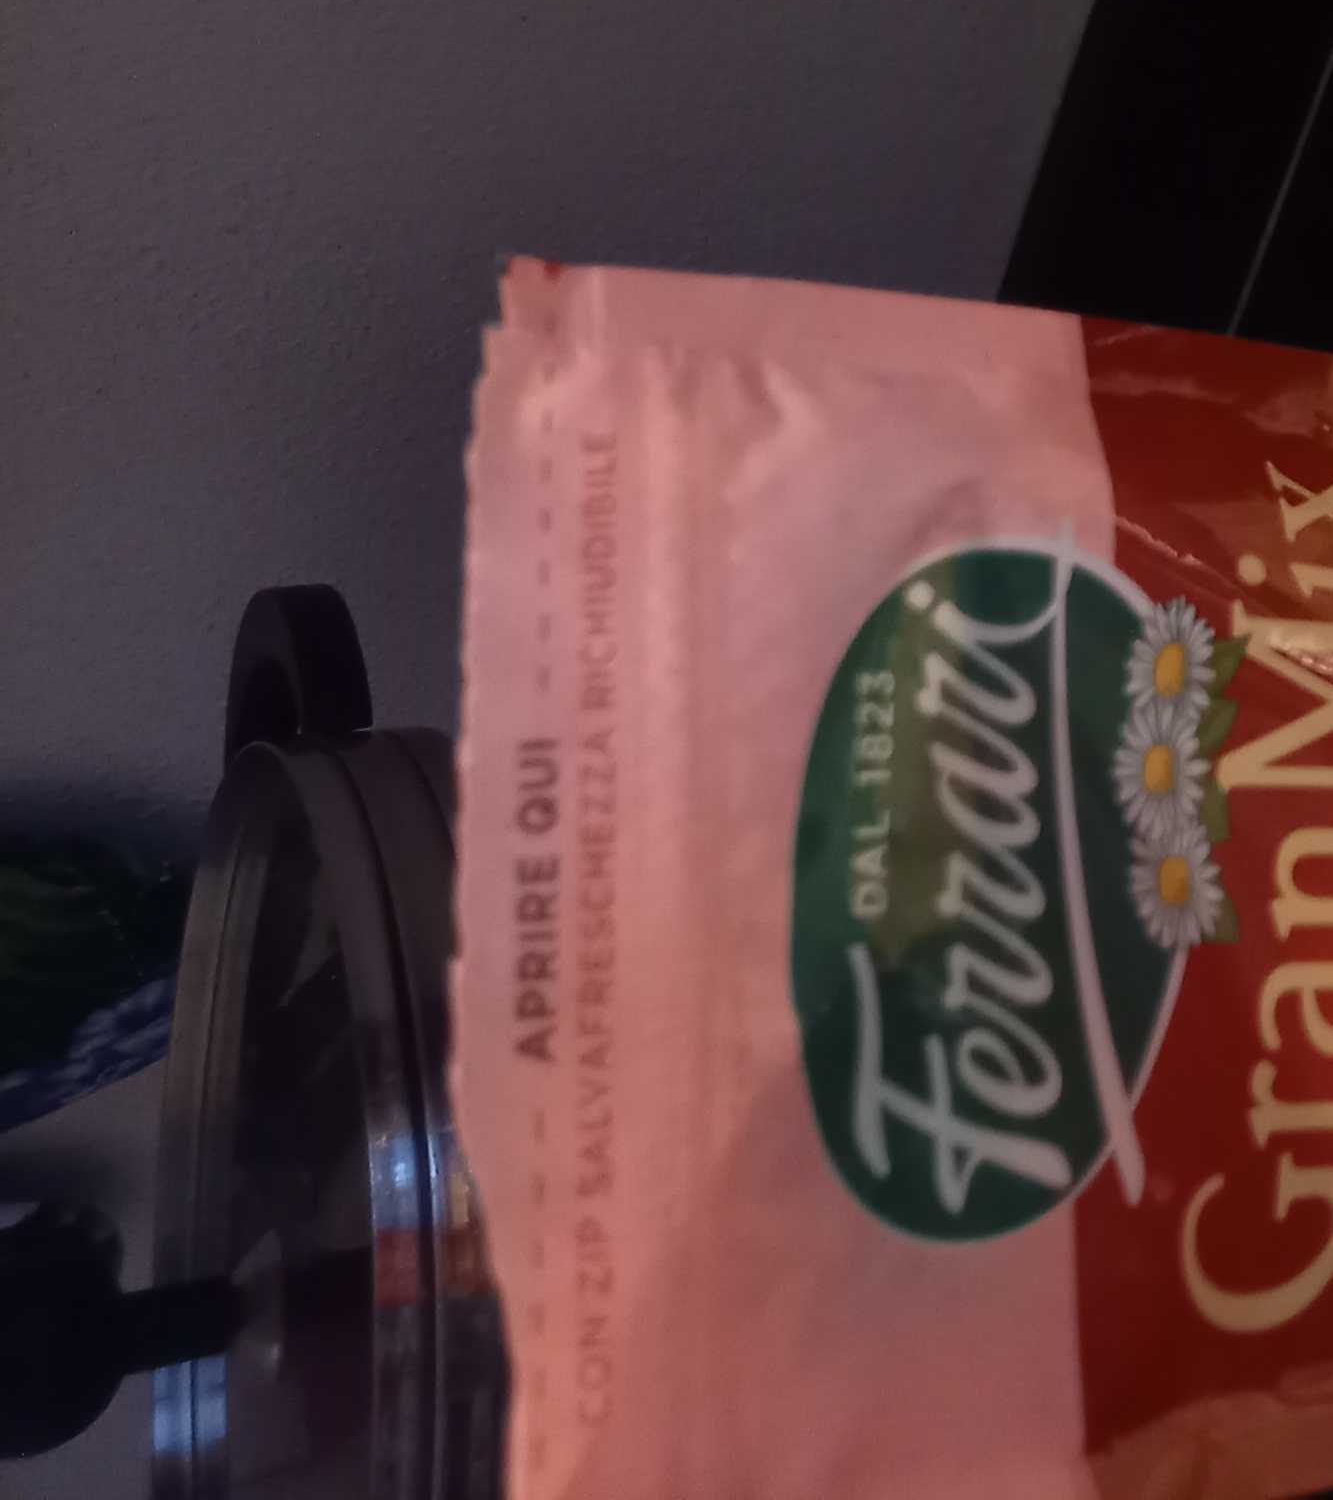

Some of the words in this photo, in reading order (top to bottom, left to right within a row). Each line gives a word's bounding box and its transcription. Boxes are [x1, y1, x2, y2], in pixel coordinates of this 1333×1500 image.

[855, 668, 898, 775] 1823
[513, 734, 561, 836] QUI
[848, 560, 1085, 1216] Ferrari
[853, 792, 888, 919] DAL
[513, 855, 561, 1065] APRIRE
[576, 1214, 618, 1296] ZIP
